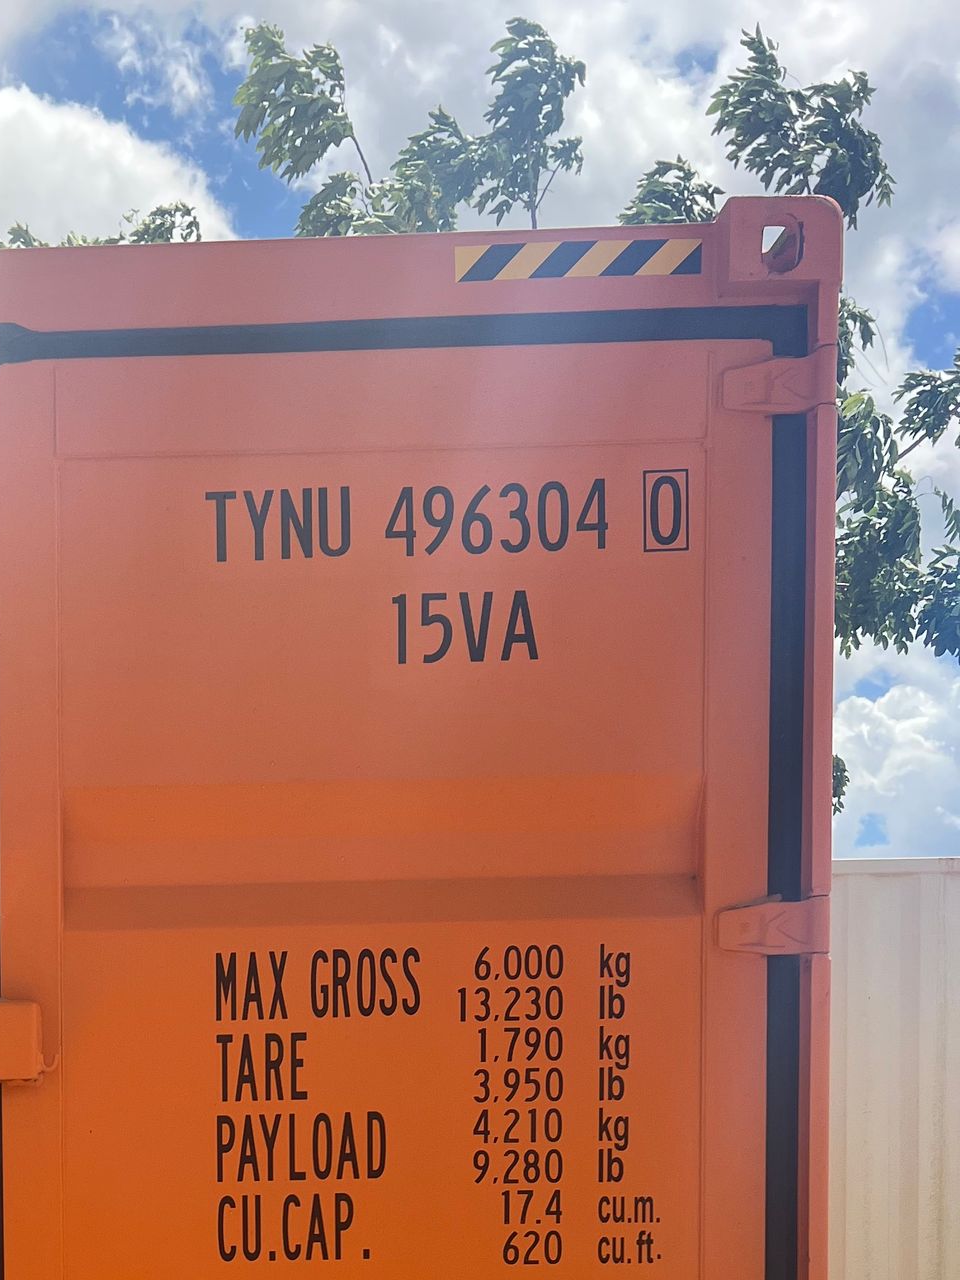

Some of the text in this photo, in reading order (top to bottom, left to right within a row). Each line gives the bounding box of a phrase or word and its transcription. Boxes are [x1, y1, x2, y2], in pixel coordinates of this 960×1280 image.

[205, 475, 683, 562] TYNU 496304 0
[392, 590, 539, 664] 15VA
[215, 947, 421, 1021] MAX GROSS
[474, 943, 631, 986] 6,000 kg
[457, 985, 625, 1022] 13,230 lb
[216, 1032, 308, 1102] TARE
[477, 1026, 630, 1070] 1,790 kg
[473, 1067, 625, 1103] 3,950 lb
[216, 1111, 386, 1182] PAYLOAD
[473, 1107, 630, 1151] 4,210 kg
[473, 1148, 624, 1184] 9,280 lb
[501, 1189, 661, 1225] 17.4 cu.m.
[503, 1230, 662, 1265] 620 cu.ft.
